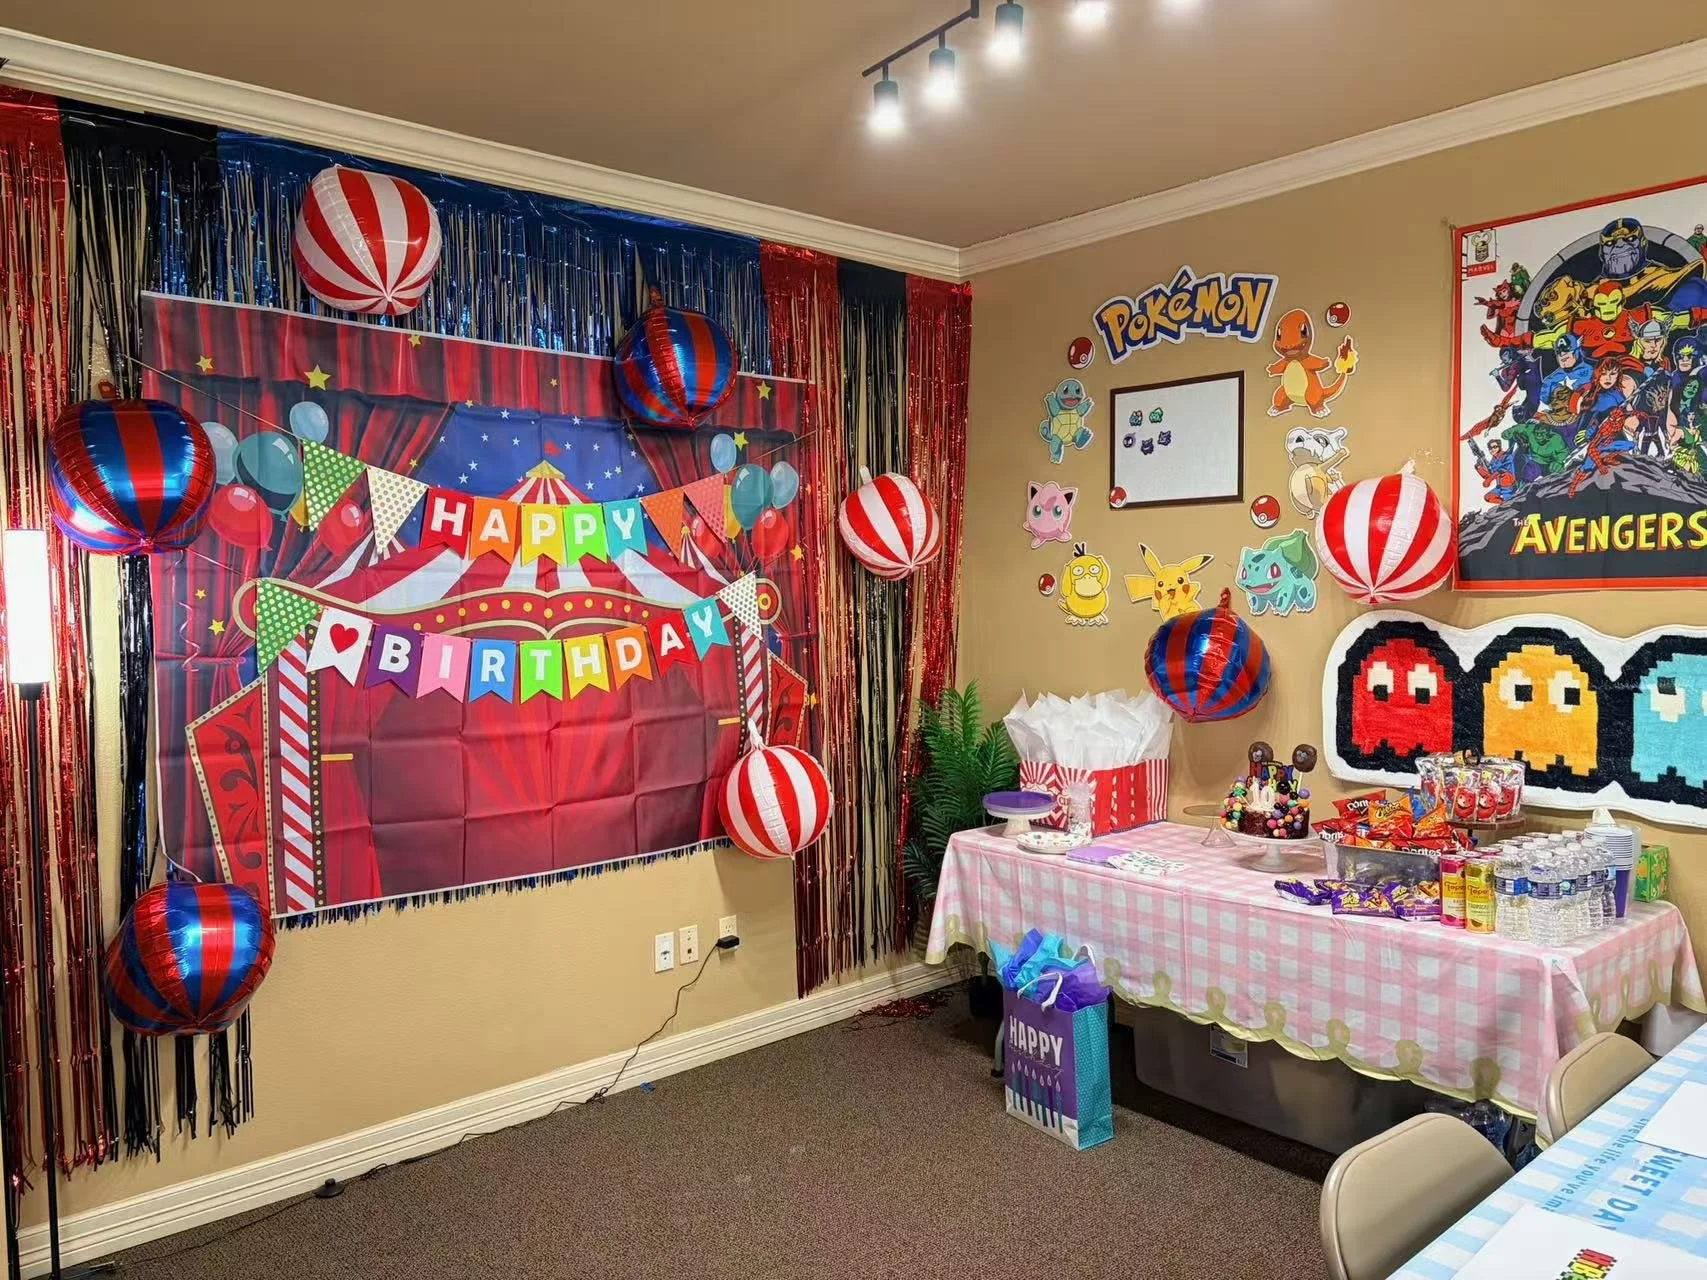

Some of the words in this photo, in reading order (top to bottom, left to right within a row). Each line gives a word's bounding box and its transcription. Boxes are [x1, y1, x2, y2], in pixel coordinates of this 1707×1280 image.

[430, 498, 636, 545] HAPPY
[1510, 509, 1707, 555] AVENGERS
[1513, 518, 1530, 528] THE
[379, 605, 714, 683] BIRTHDAY
[1009, 1014, 1064, 1067] HAPPY
